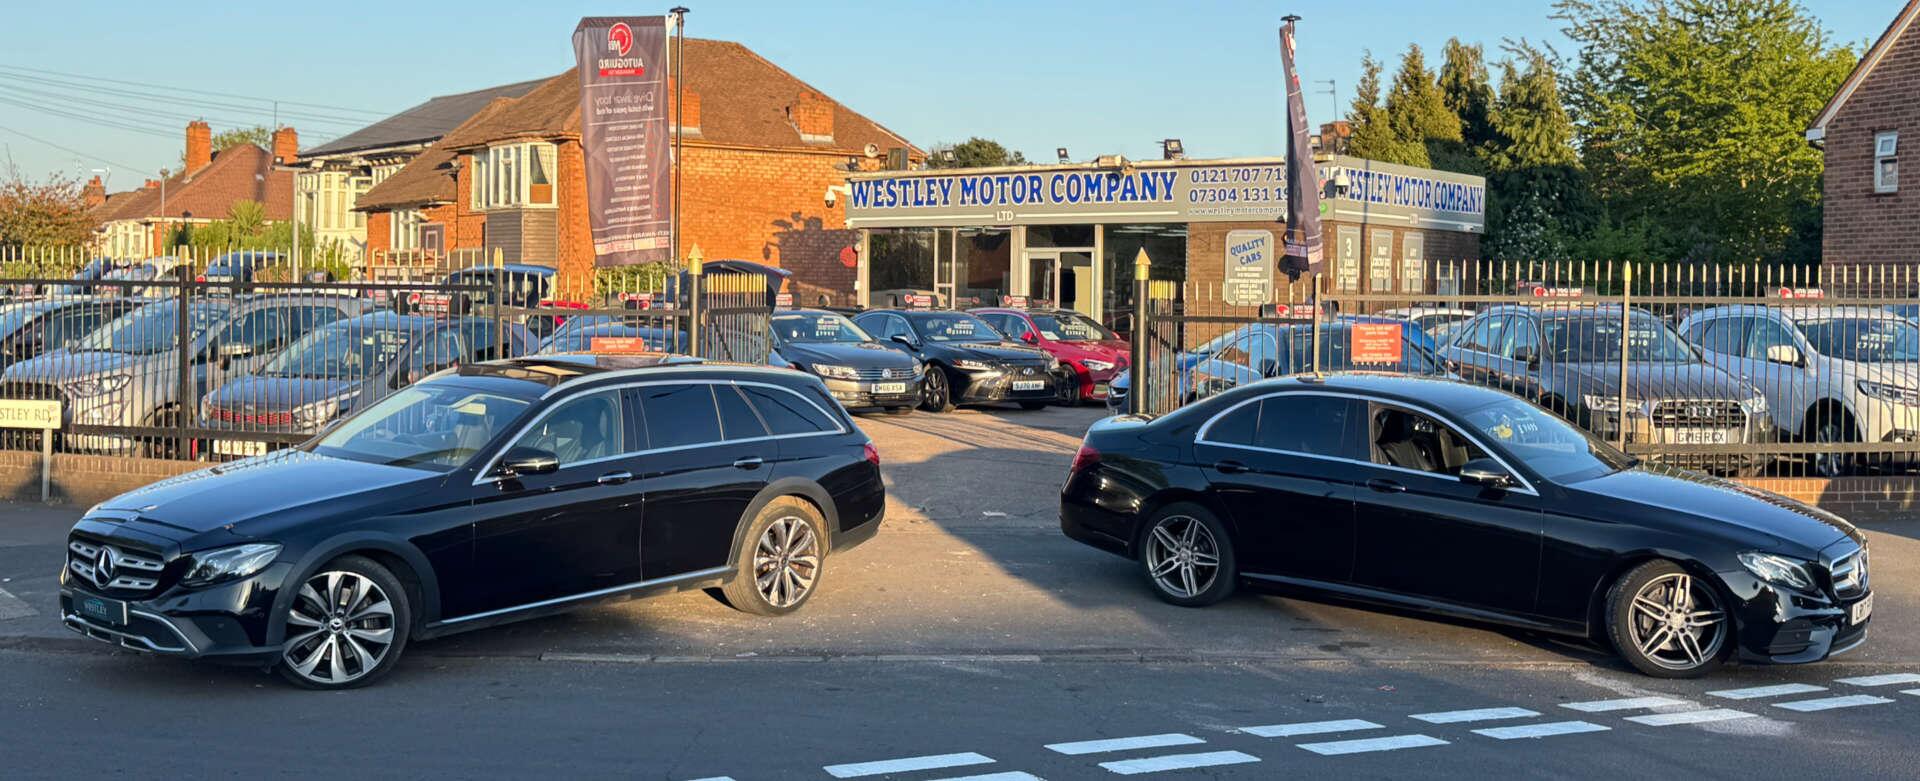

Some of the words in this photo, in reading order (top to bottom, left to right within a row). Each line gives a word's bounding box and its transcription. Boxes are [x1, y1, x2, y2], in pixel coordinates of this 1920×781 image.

[1191, 169, 1228, 183] 0121
[1232, 168, 1260, 182] 707
[850, 177, 954, 208] WESTLEY
[960, 174, 1043, 206] MOTOR
[1050, 170, 1178, 203] COMPANY
[1190, 188, 1237, 202] 07304
[1242, 188, 1270, 201] 131
[1394, 176, 1432, 208] MOTOR
[1434, 180, 1484, 214] COMPANY
[996, 210, 1014, 222] LTD
[1230, 236, 1265, 256] QUALITY
[1346, 238, 1352, 257] 3
[1240, 251, 1262, 265] CARS
